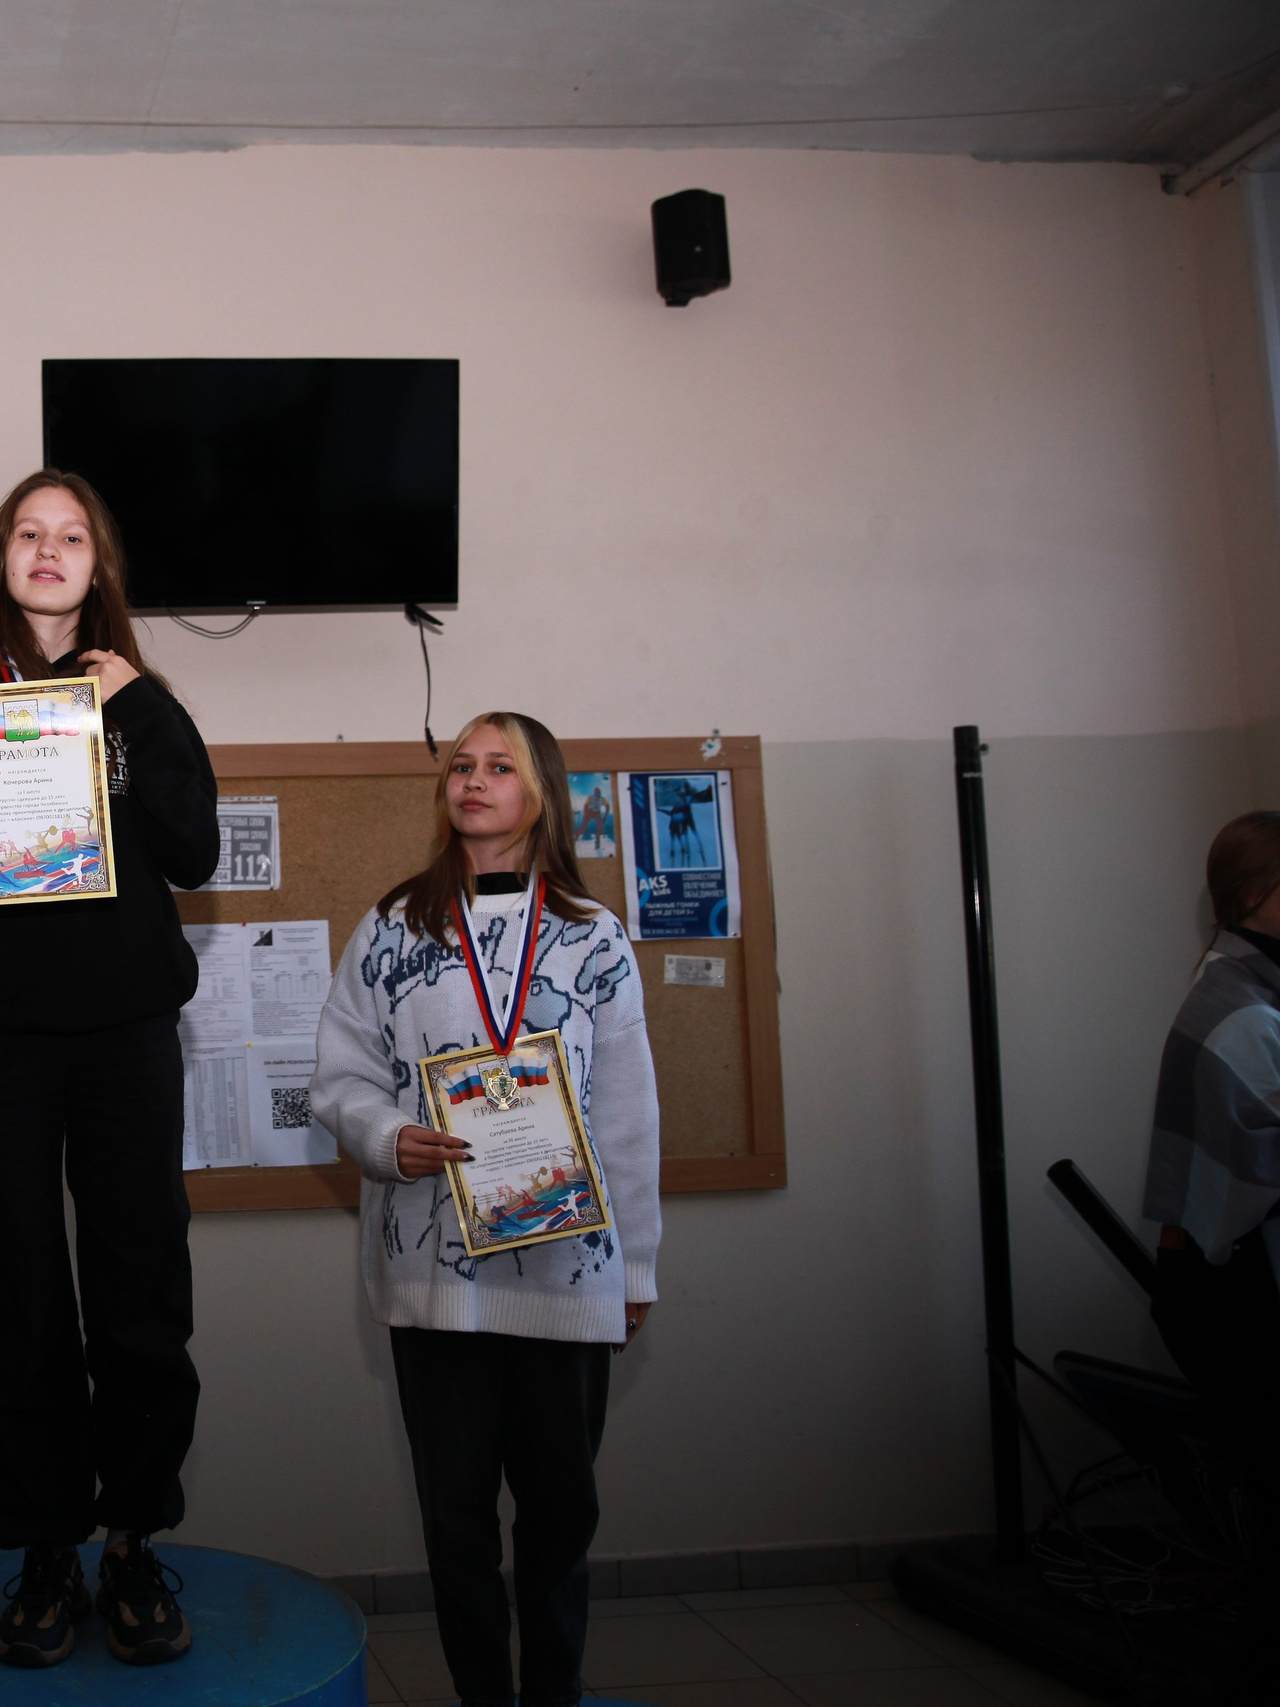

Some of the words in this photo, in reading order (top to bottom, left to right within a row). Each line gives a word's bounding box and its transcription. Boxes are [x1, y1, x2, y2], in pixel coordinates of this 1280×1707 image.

[3, 778, 32, 787] Кочерова
[33, 777, 53, 785] Арина
[234, 854, 270, 881] 112
[639, 875, 668, 891] AKS
[653, 888, 671, 896] kids
[489, 1128, 517, 1138] Сатубаева
[517, 1124, 535, 1133] Арина
